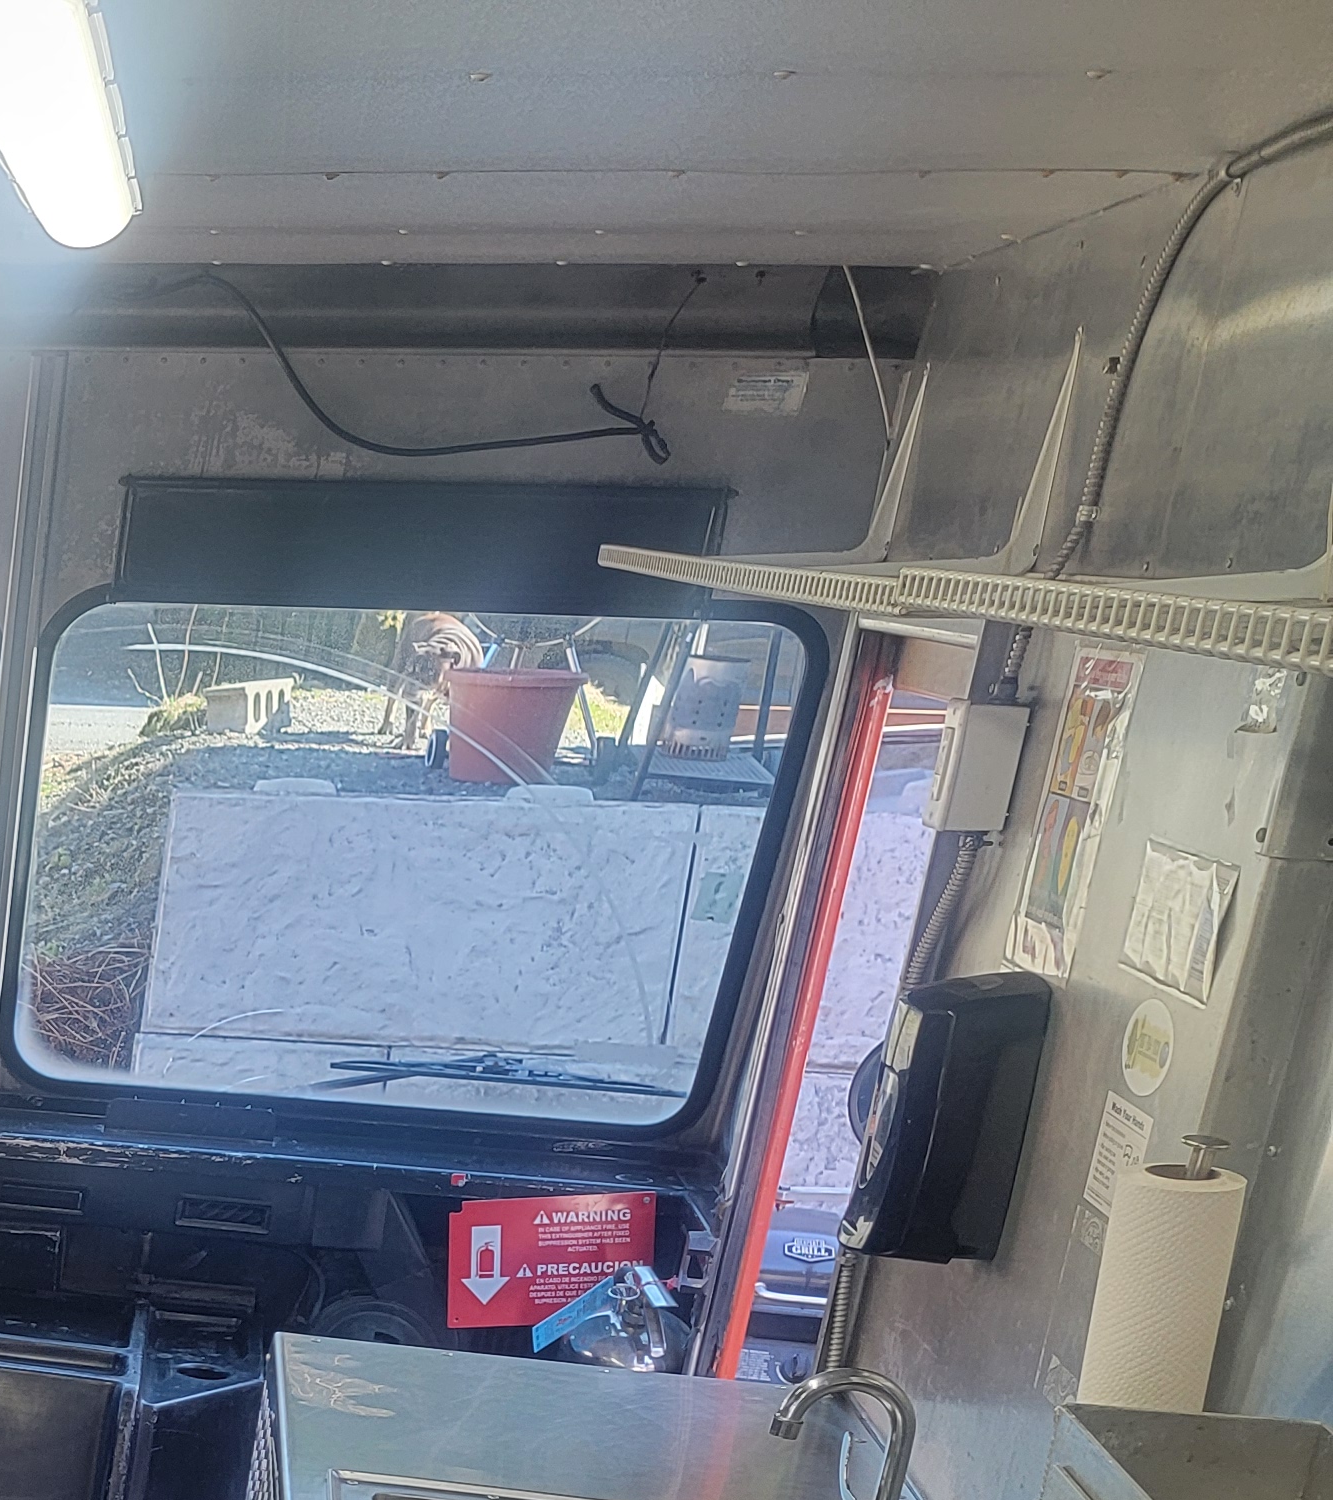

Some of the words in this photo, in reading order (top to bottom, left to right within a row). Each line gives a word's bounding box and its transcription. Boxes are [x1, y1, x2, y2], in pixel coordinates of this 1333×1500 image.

[1111, 1101, 1122, 1116] Wash
[1122, 1108, 1132, 1122] Your
[552, 1209, 632, 1224] WARNING
[792, 1245, 829, 1256] GRILL
